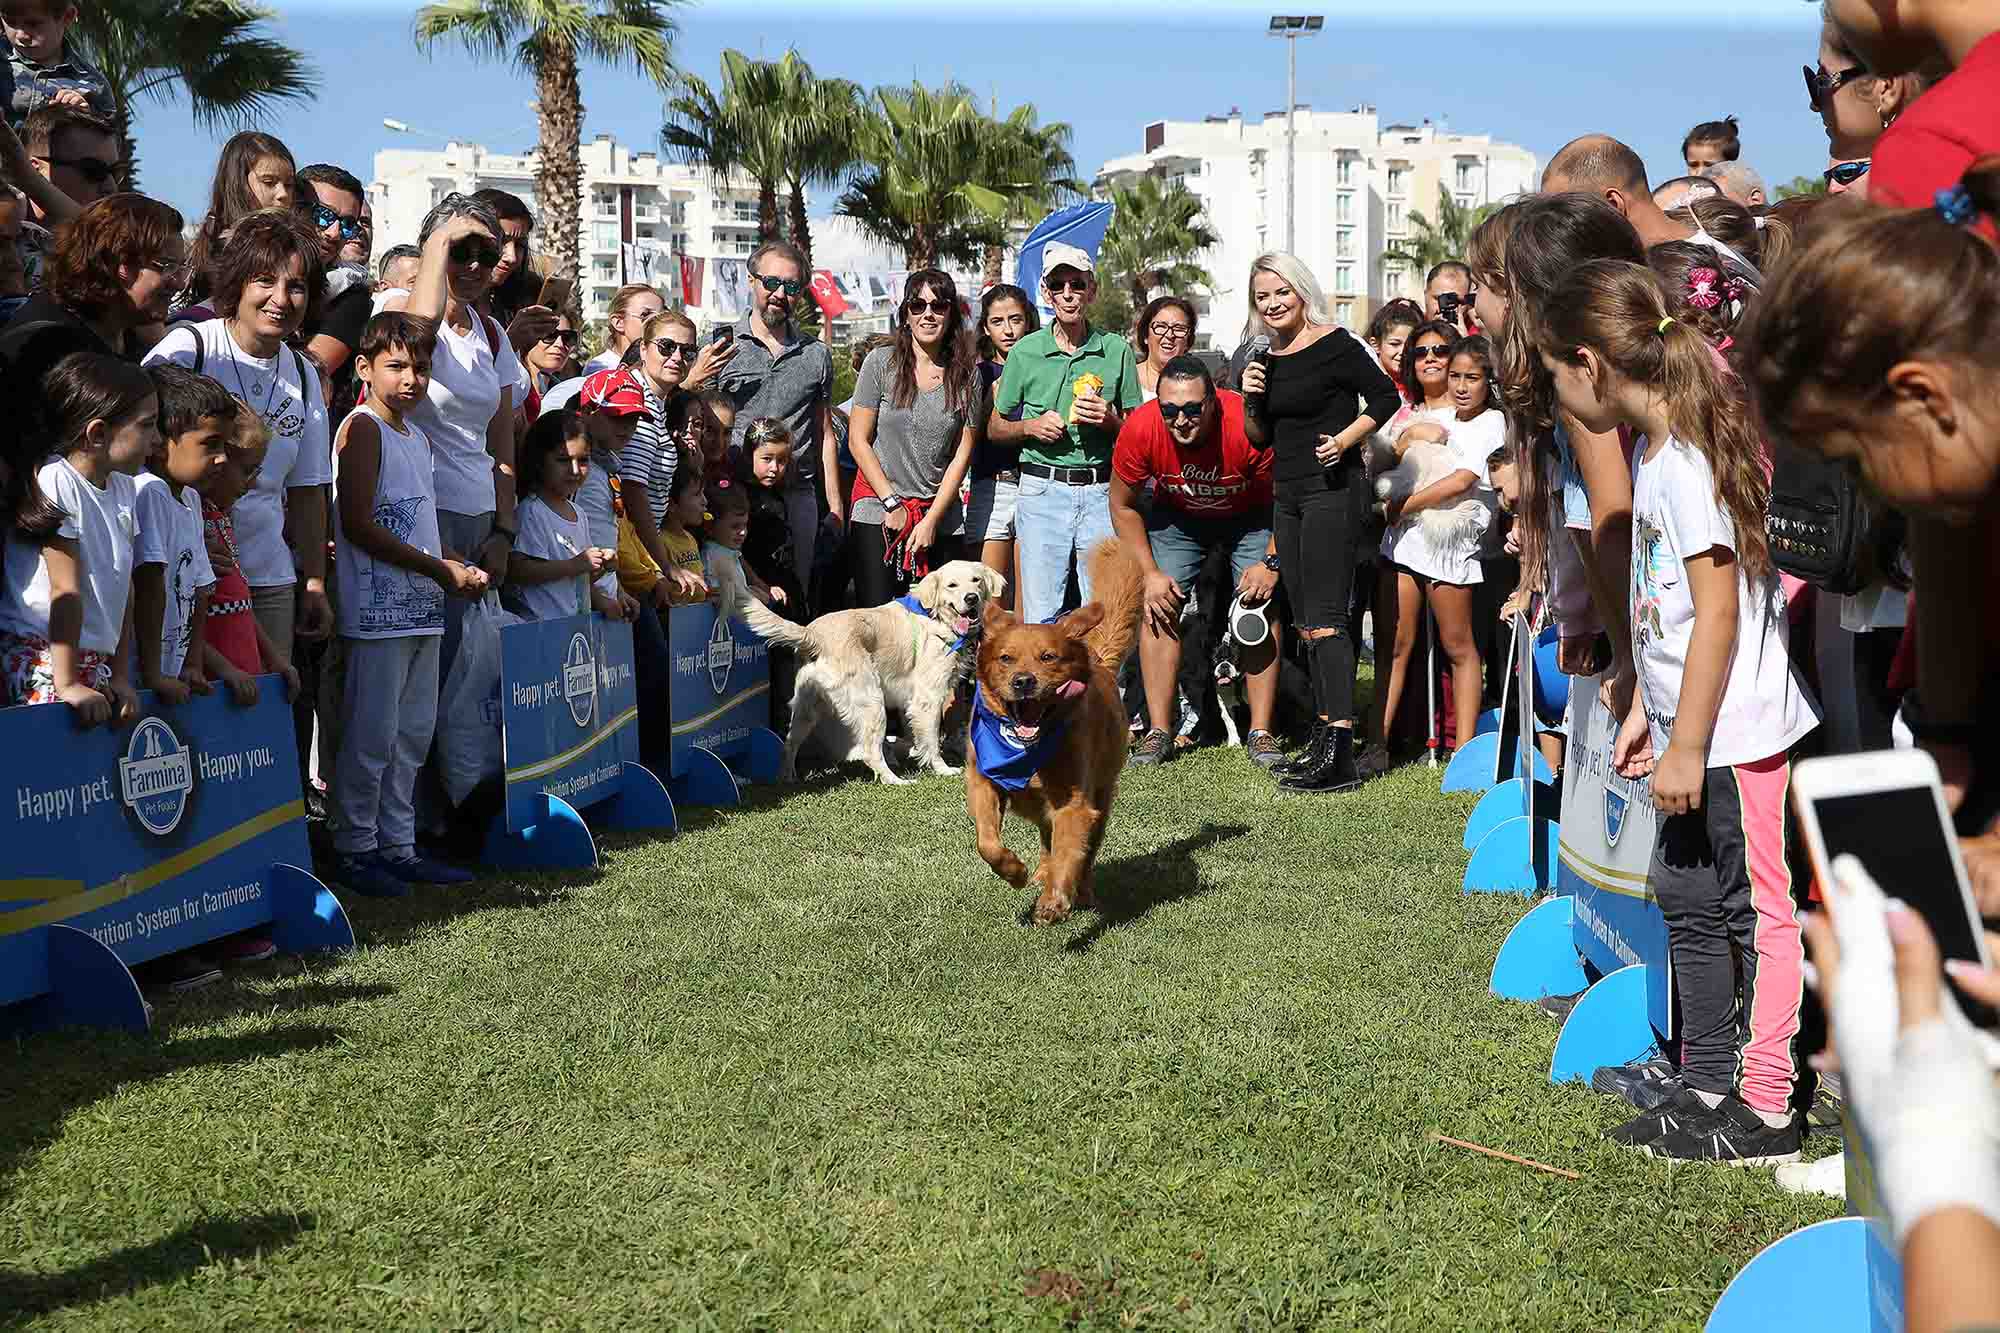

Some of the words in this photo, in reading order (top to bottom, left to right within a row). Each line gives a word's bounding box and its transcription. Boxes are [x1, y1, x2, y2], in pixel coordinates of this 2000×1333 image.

[1182, 464, 1219, 481] Bad
[512, 682, 542, 710] Happy
[544, 675, 561, 705] pet.
[128, 761, 186, 795] Farmina
[199, 751, 241, 783] Happy
[246, 747, 274, 776] you.
[17, 786, 75, 822] Happy
[80, 775, 114, 815] pet.
[91, 917, 133, 946] trition
[136, 908, 181, 938] System
[183, 899, 200, 921] for
[202, 880, 262, 914] Carnivores
